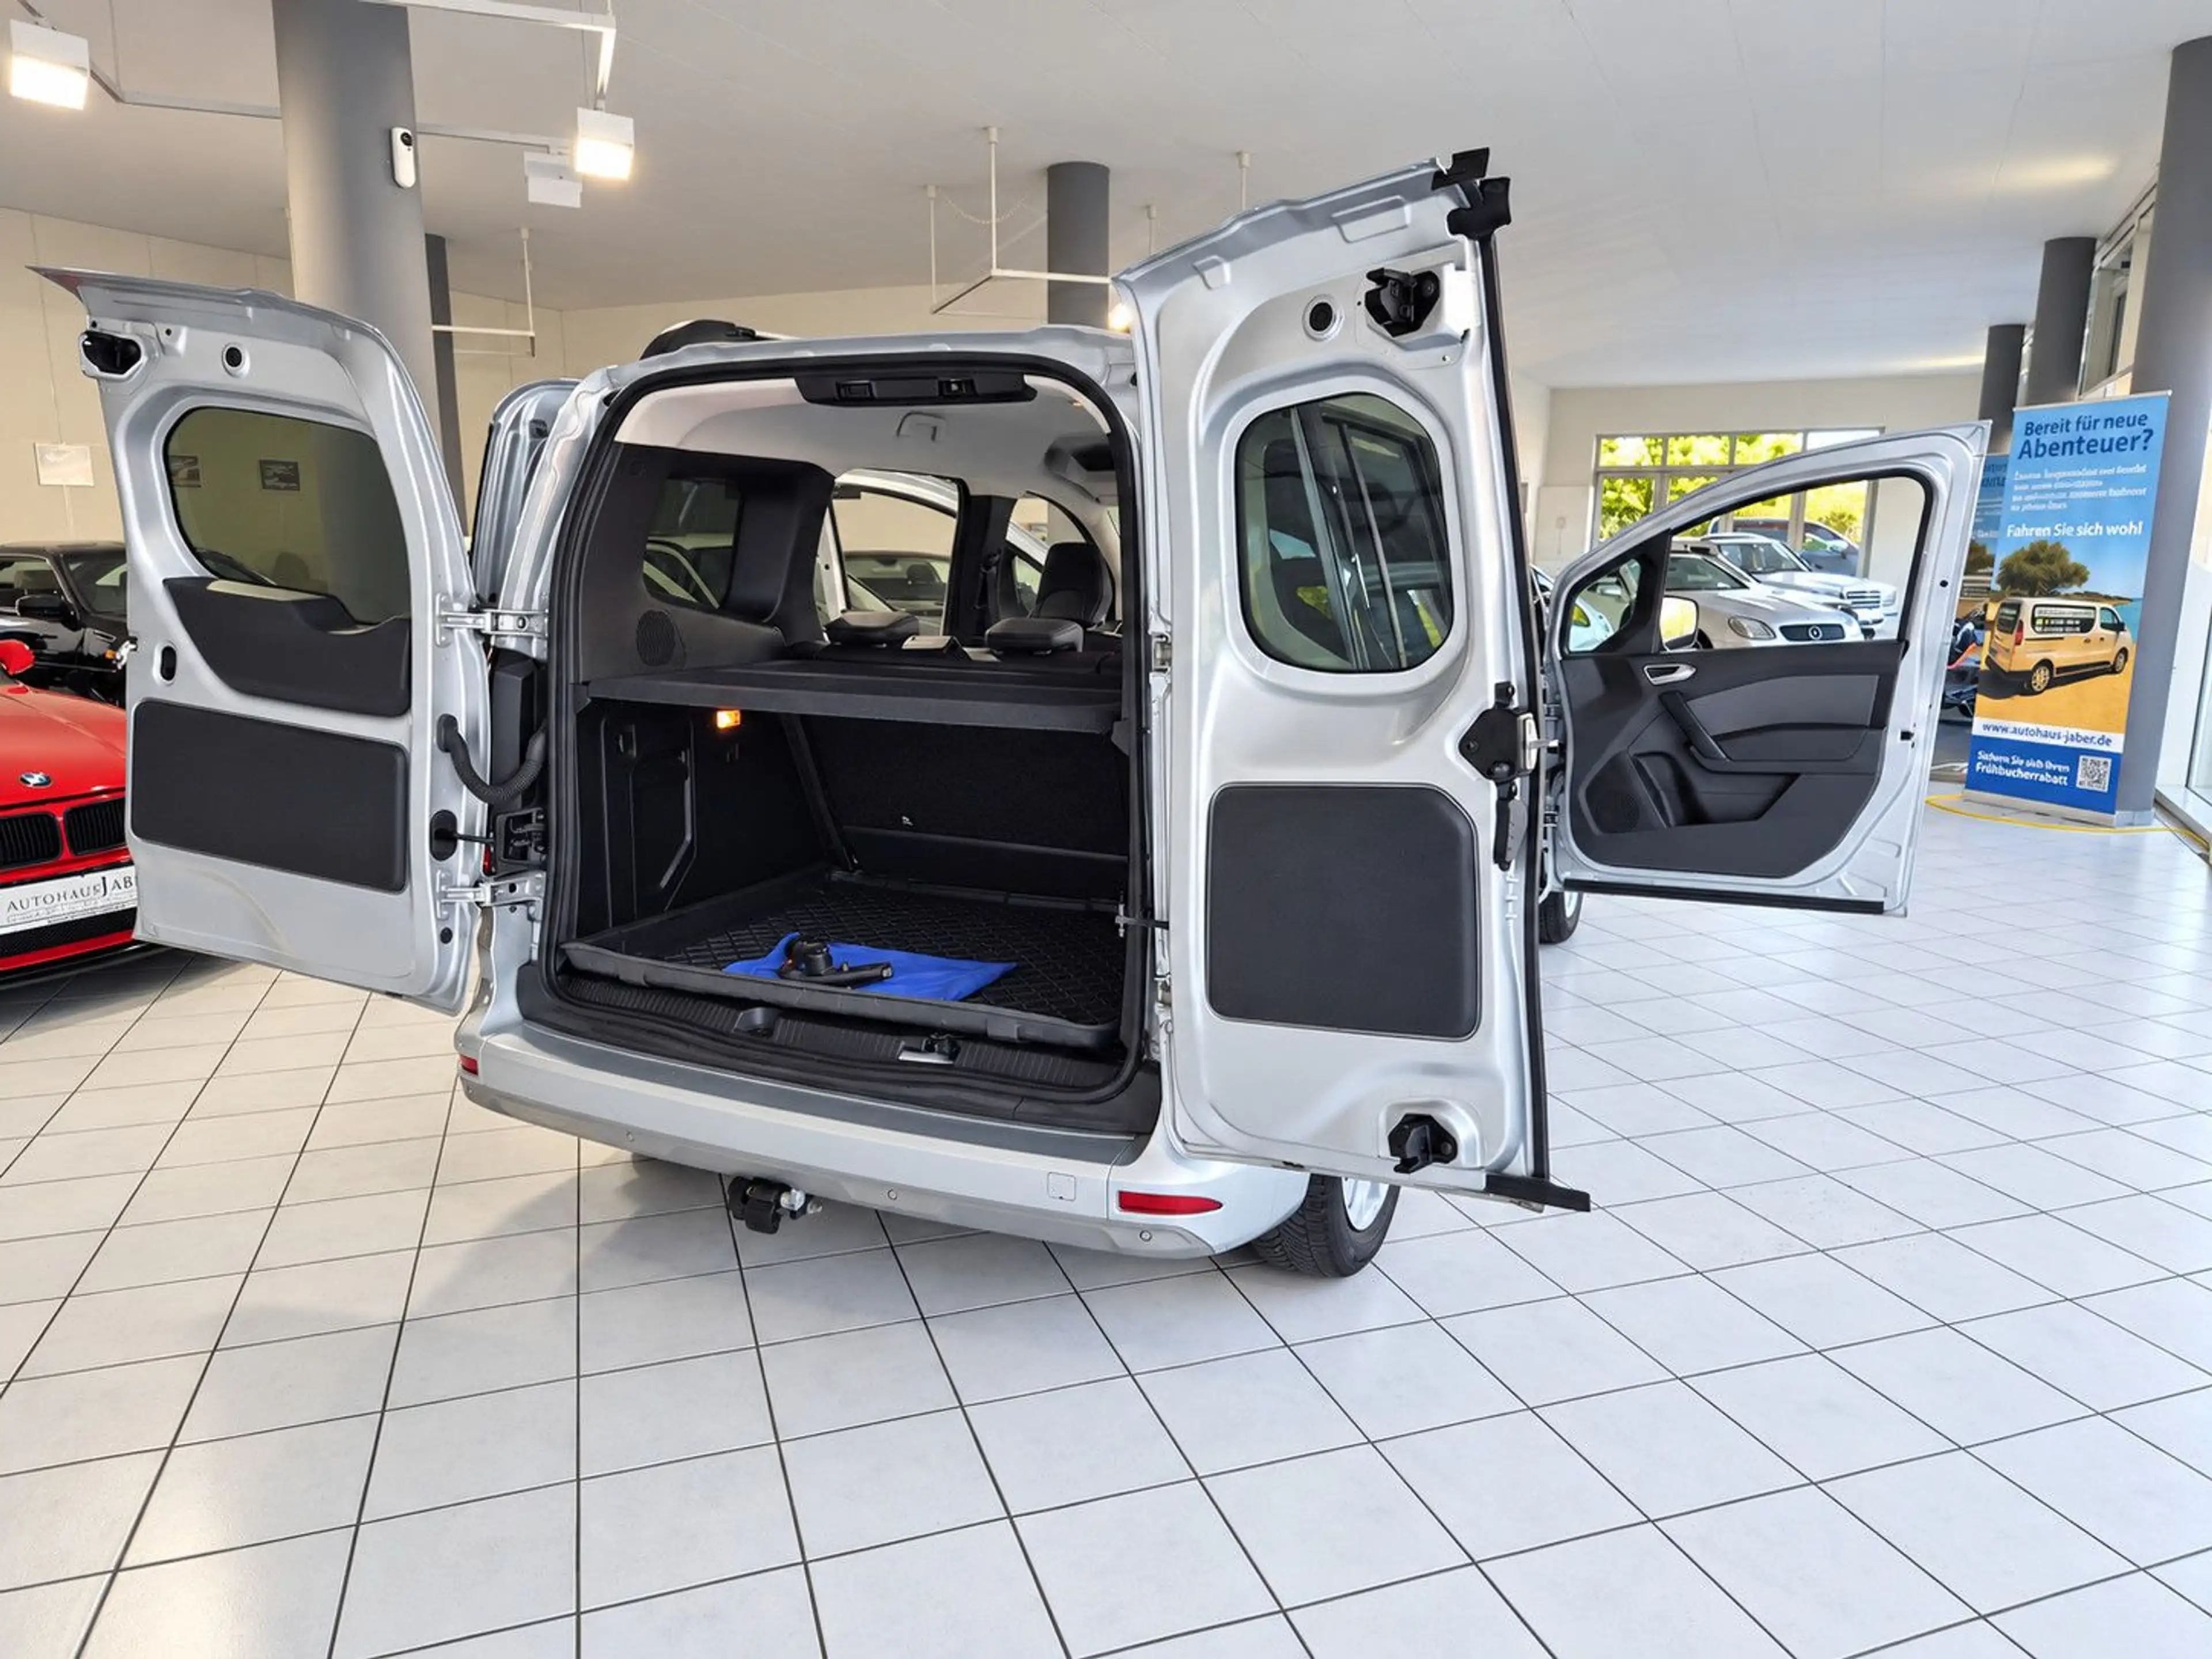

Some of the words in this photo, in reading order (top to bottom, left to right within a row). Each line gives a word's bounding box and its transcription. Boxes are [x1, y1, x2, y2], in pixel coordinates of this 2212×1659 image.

[2024, 418, 2072, 437] Bereit
[2075, 414, 2100, 432] für
[2103, 412, 2148, 429] neue
[2018, 428, 2154, 460] Abenteuer?
[2006, 522, 2051, 537] Fahren
[2053, 522, 2074, 537] Sie
[2076, 521, 2103, 536] sich
[1982, 722, 2113, 747] www.autohaus-jaber.de
[2011, 755, 2024, 766] Sie
[1975, 762, 2068, 786] Frühbucherrabatt
[7, 886, 100, 913] AUTOHAUS
